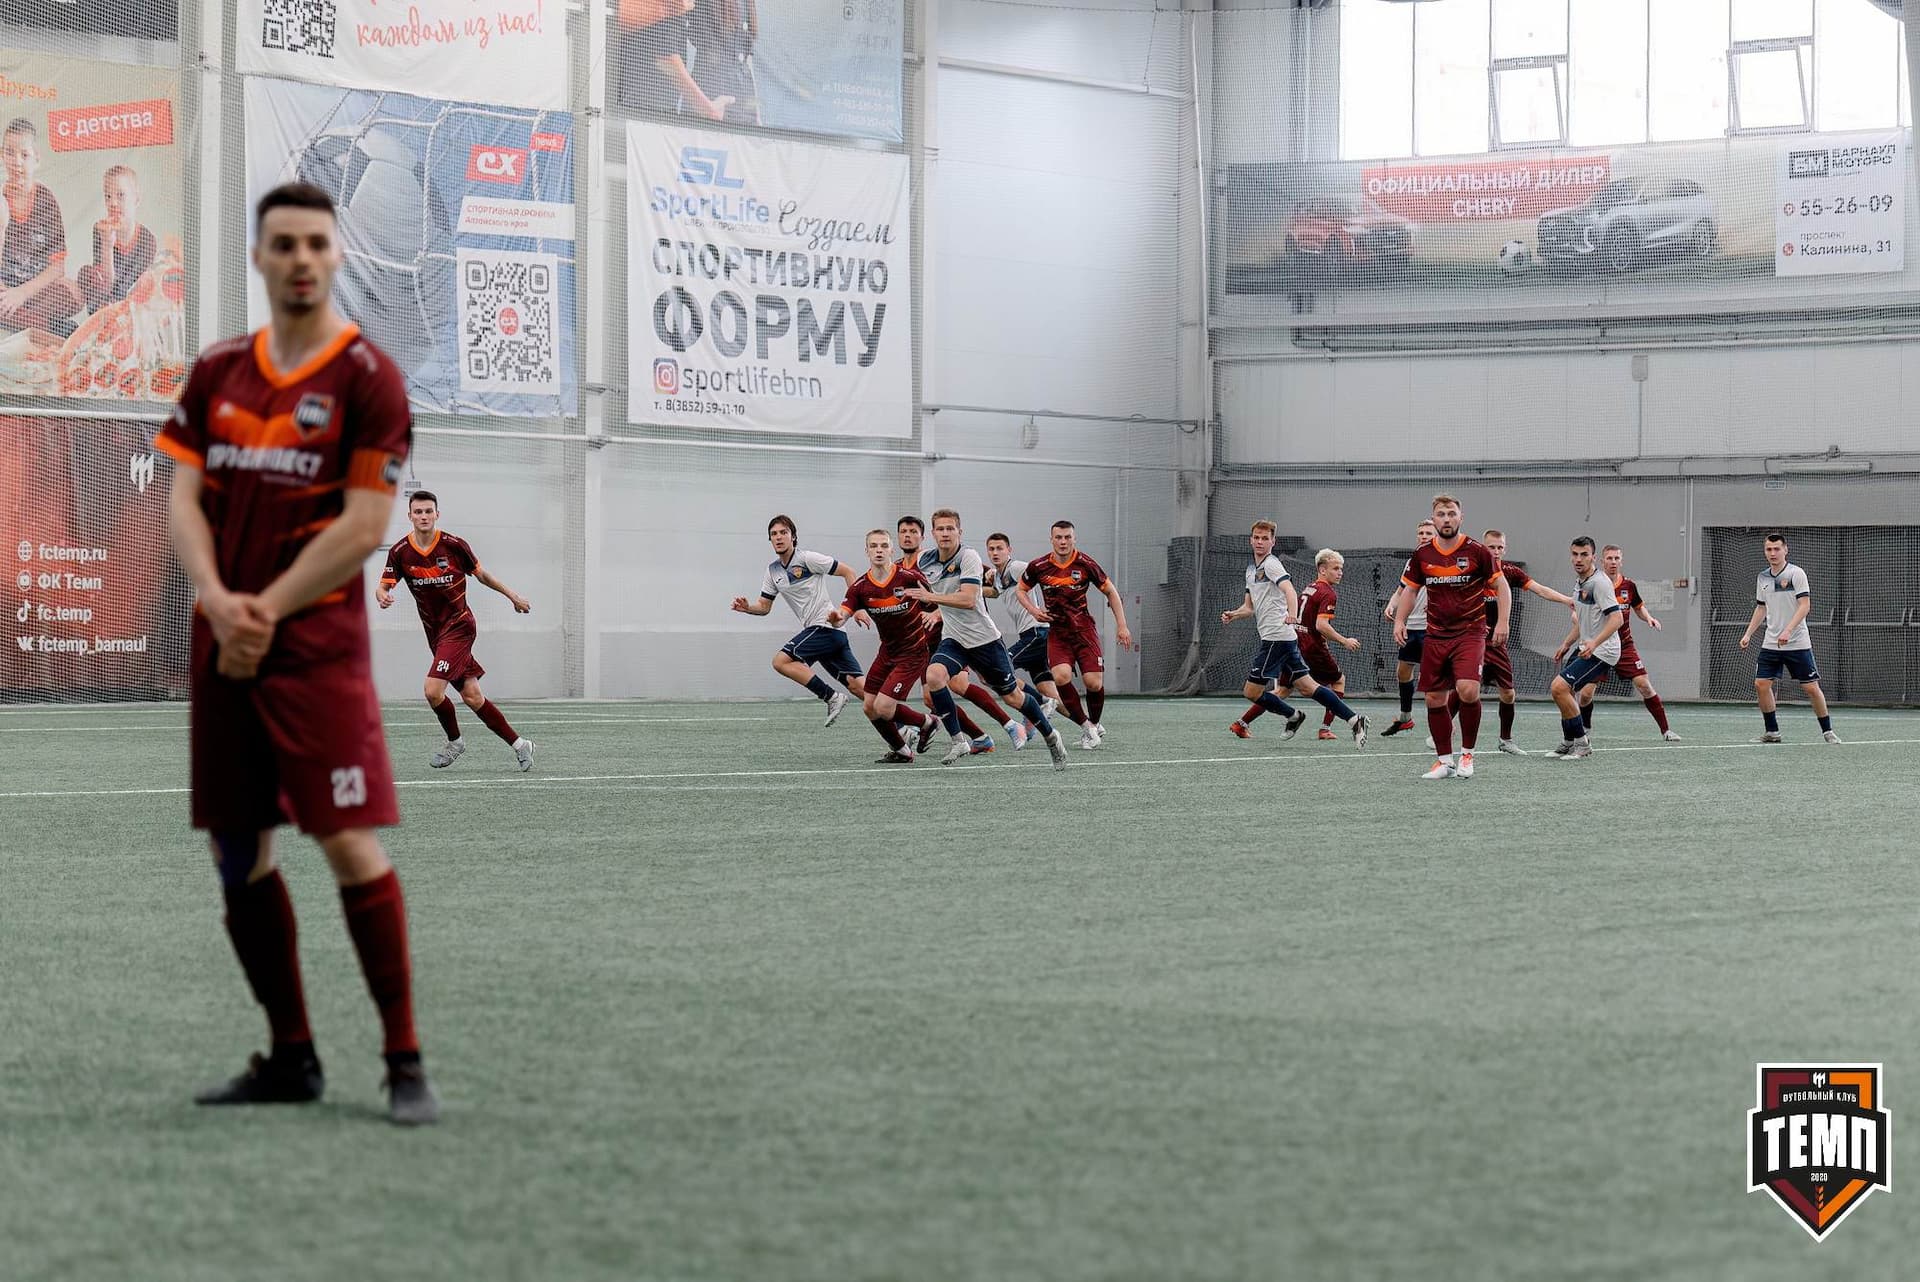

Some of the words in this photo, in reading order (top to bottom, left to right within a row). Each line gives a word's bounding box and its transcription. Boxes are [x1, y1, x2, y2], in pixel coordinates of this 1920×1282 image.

[356, 6, 459, 47] каждом
[464, 16, 491, 49] из
[57, 121, 70, 137] с
[75, 111, 153, 138] детства
[1831, 144, 1896, 159] БАРНАУЛ
[1831, 155, 1893, 169] МОТОРС
[1367, 166, 1531, 197] ОФИЦИАЛЬНЫЙ
[1534, 164, 1606, 191] ДИЛЕР
[650, 186, 770, 224] SportLife
[1800, 194, 1893, 217] 55-26-09
[778, 199, 897, 251] Создаем
[1800, 231, 1846, 243] проспект
[1800, 243, 1872, 256] Калинина,
[1876, 239, 1891, 253] 31
[652, 237, 889, 295] СПОРТИВНУЮ
[652, 285, 888, 368] ФОРМУ
[682, 366, 822, 398] sportlifebrn
[665, 399, 704, 415] 8(3852)
[38, 542, 108, 564] fctemp.ru
[37, 572, 62, 590] ФК
[63, 573, 103, 590] Темп
[37, 603, 93, 624] fc.temp
[37, 633, 147, 656] fctemp_barnaul
[436, 659, 450, 673] 24
[330, 765, 368, 808] 23
